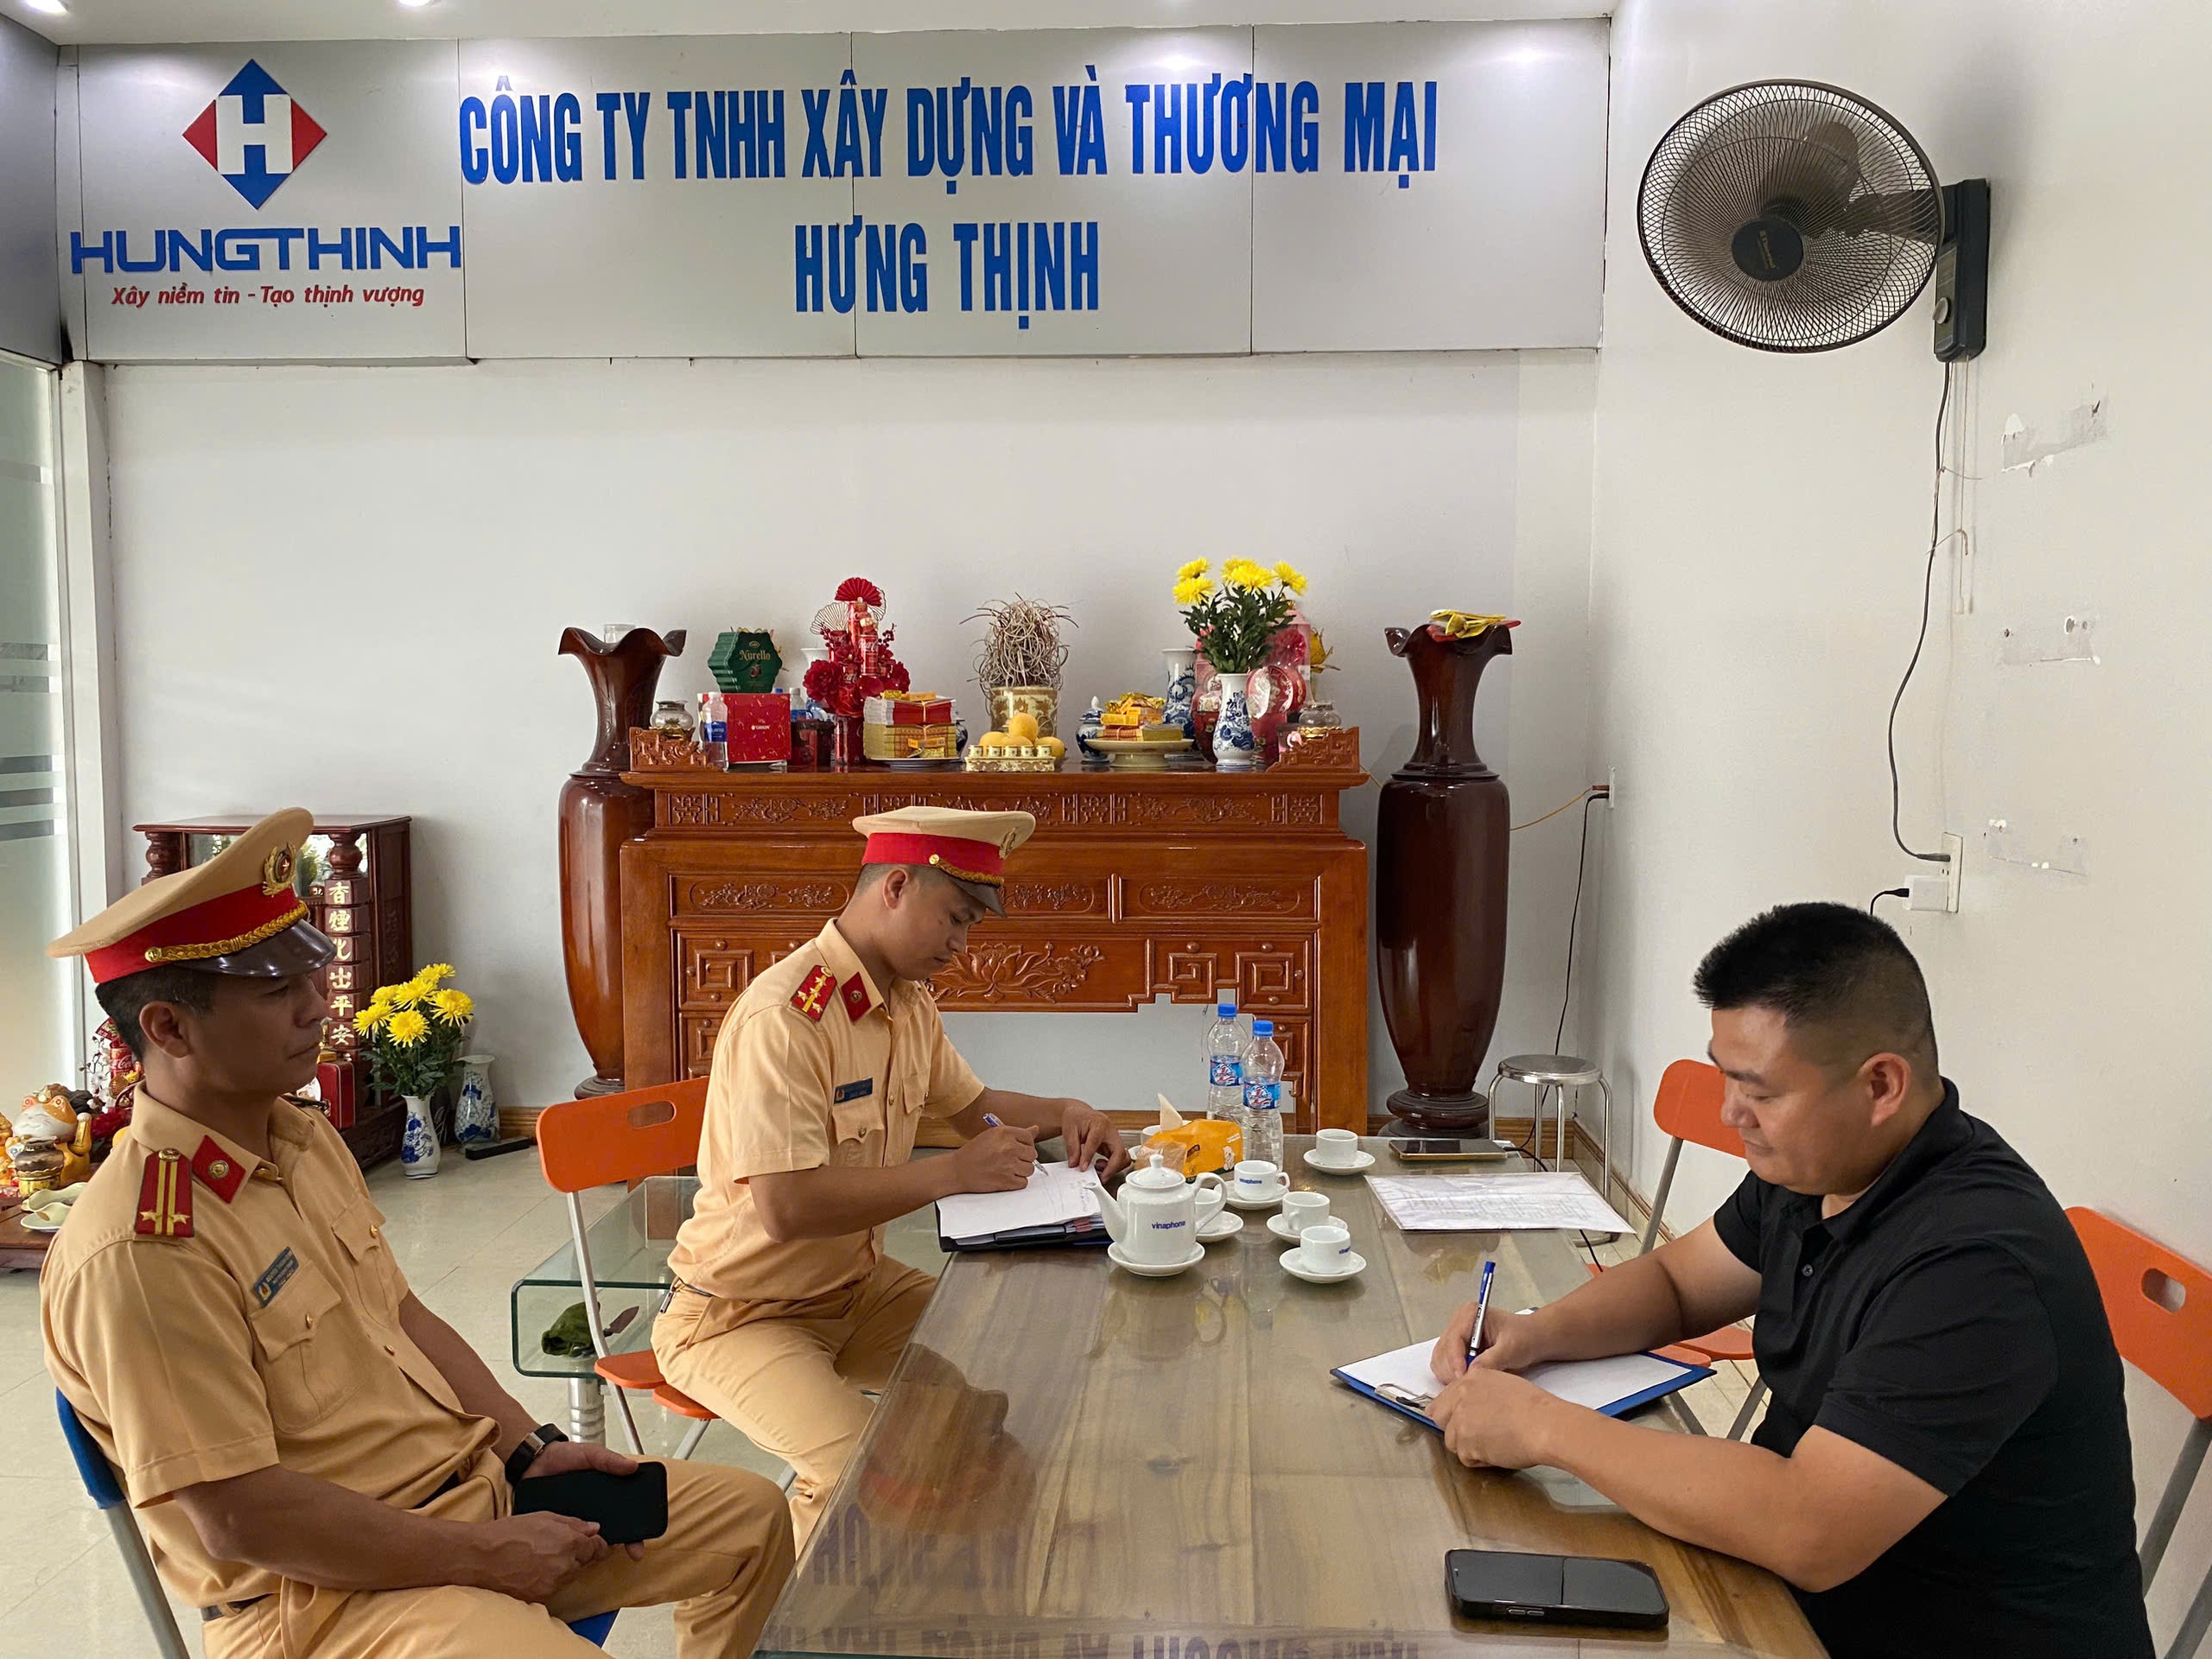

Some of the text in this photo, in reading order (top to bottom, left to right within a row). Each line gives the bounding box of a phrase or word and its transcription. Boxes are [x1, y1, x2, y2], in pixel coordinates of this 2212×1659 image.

[459, 65, 1437, 195] CÔNG TY TNHH XÂY DỰNG VÀ THƯƠNG MẠI
[71, 226, 461, 274] HUNGTHINH
[796, 215, 1099, 330] HƯNG THỊNH
[111, 286, 149, 309] Xây
[157, 282, 205, 305] niềm
[213, 286, 240, 305] tin
[261, 286, 295, 309] Tạo
[303, 284, 353, 309] thịnh
[362, 285, 424, 308] vượng
[1151, 1220, 1186, 1230] vinaphone
